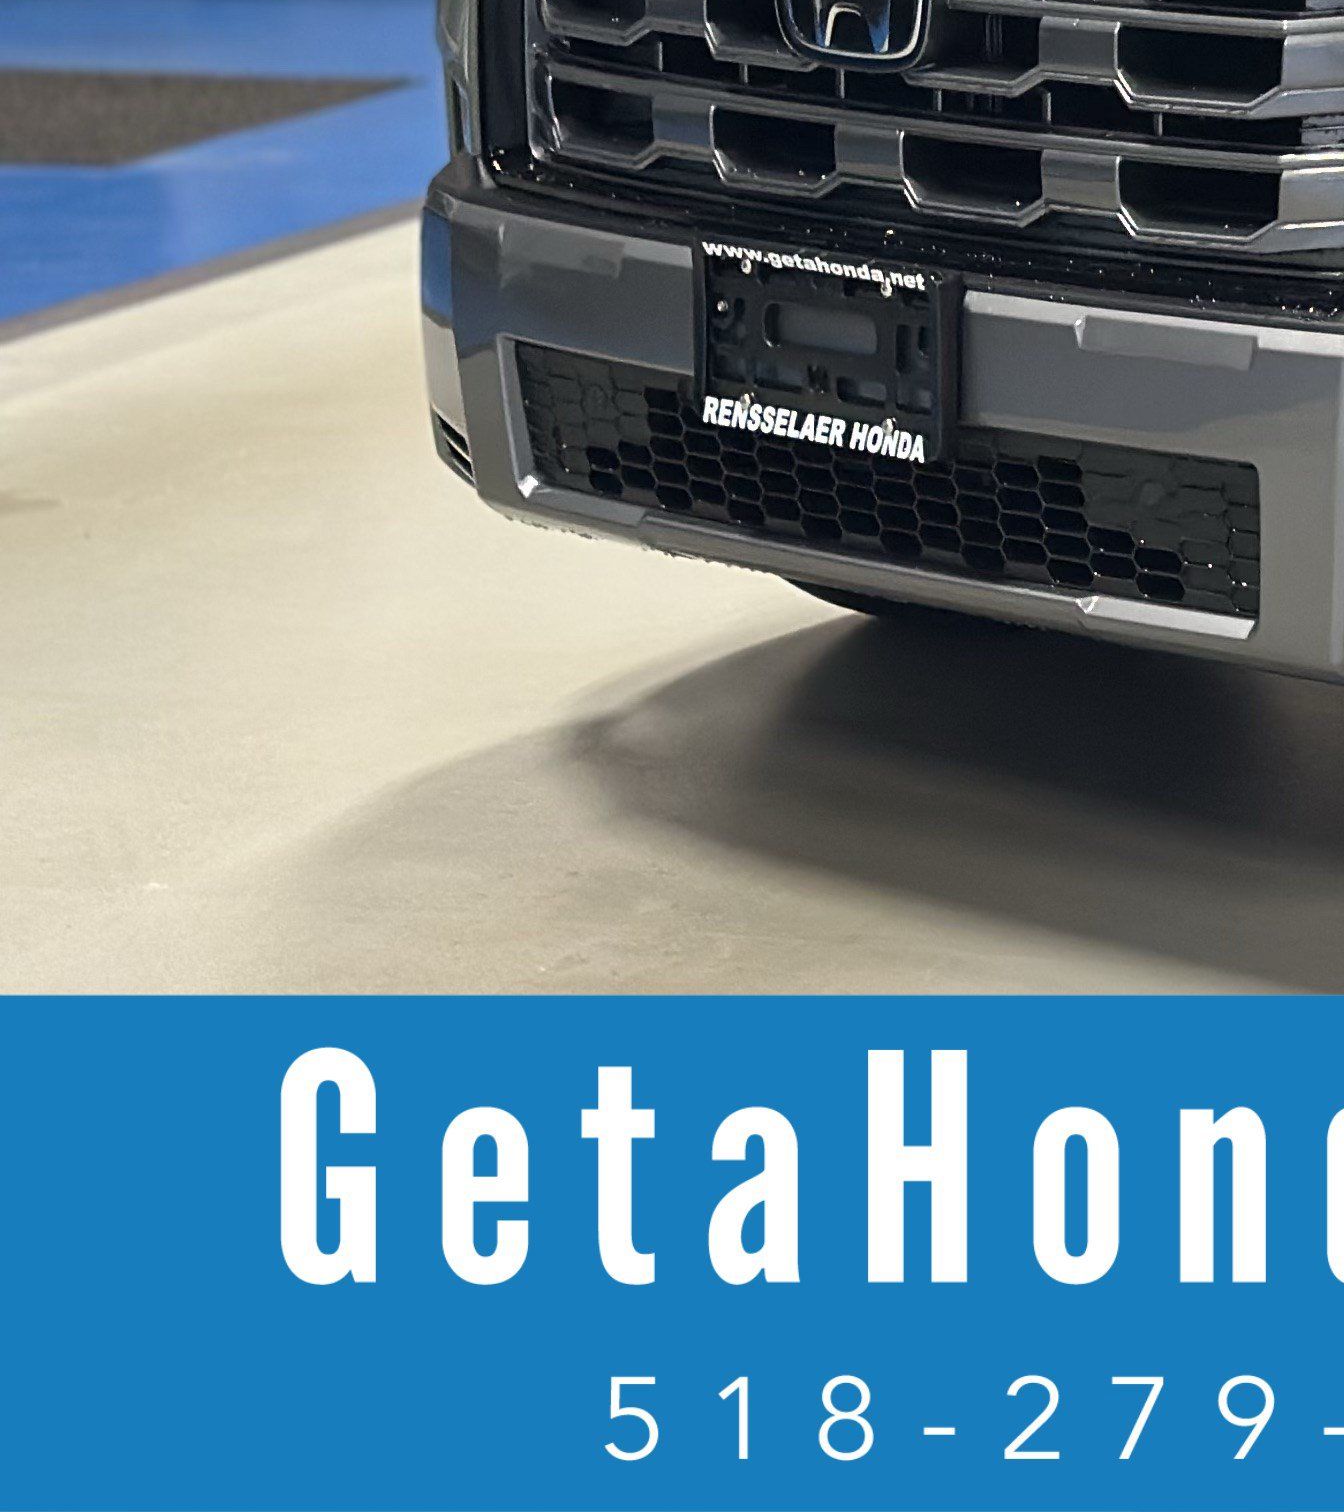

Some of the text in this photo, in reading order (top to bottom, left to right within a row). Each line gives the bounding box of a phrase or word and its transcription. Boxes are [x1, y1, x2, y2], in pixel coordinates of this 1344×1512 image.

[702, 240, 925, 291] www.getahonda.net
[702, 396, 925, 464] RENSSELAER HONDA
